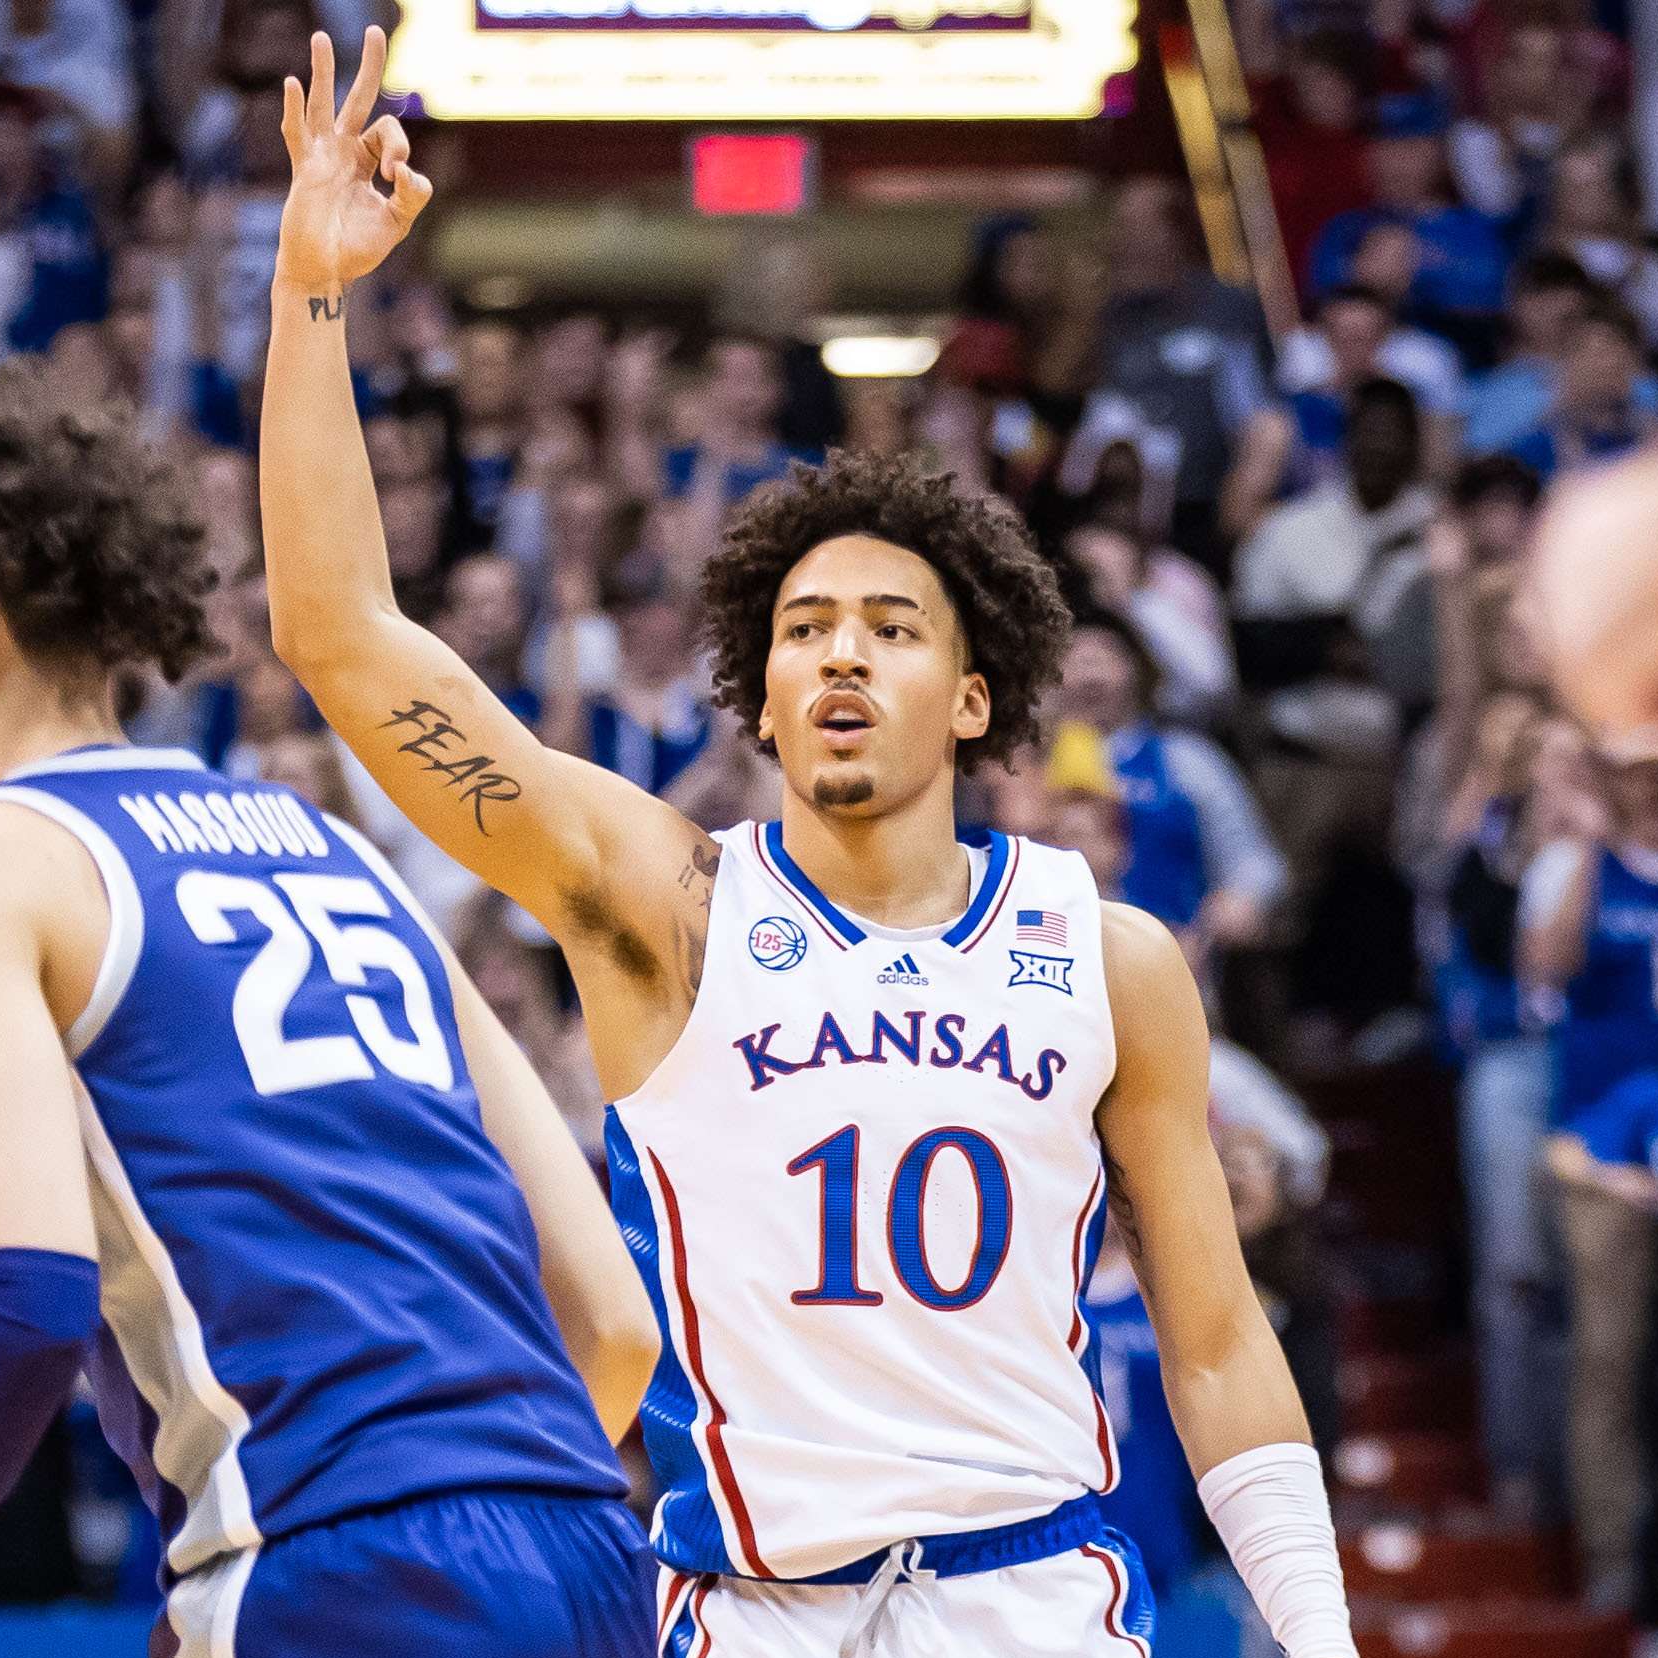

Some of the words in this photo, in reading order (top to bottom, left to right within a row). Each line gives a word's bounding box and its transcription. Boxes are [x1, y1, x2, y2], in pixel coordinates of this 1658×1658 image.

[375, 700, 521, 837] FEAR
[175, 869, 454, 1097] 25
[754, 931, 781, 951] 125
[877, 972, 930, 986] adidas
[732, 1010, 1067, 1101] KANSAS
[787, 1123, 1013, 1312] 10
